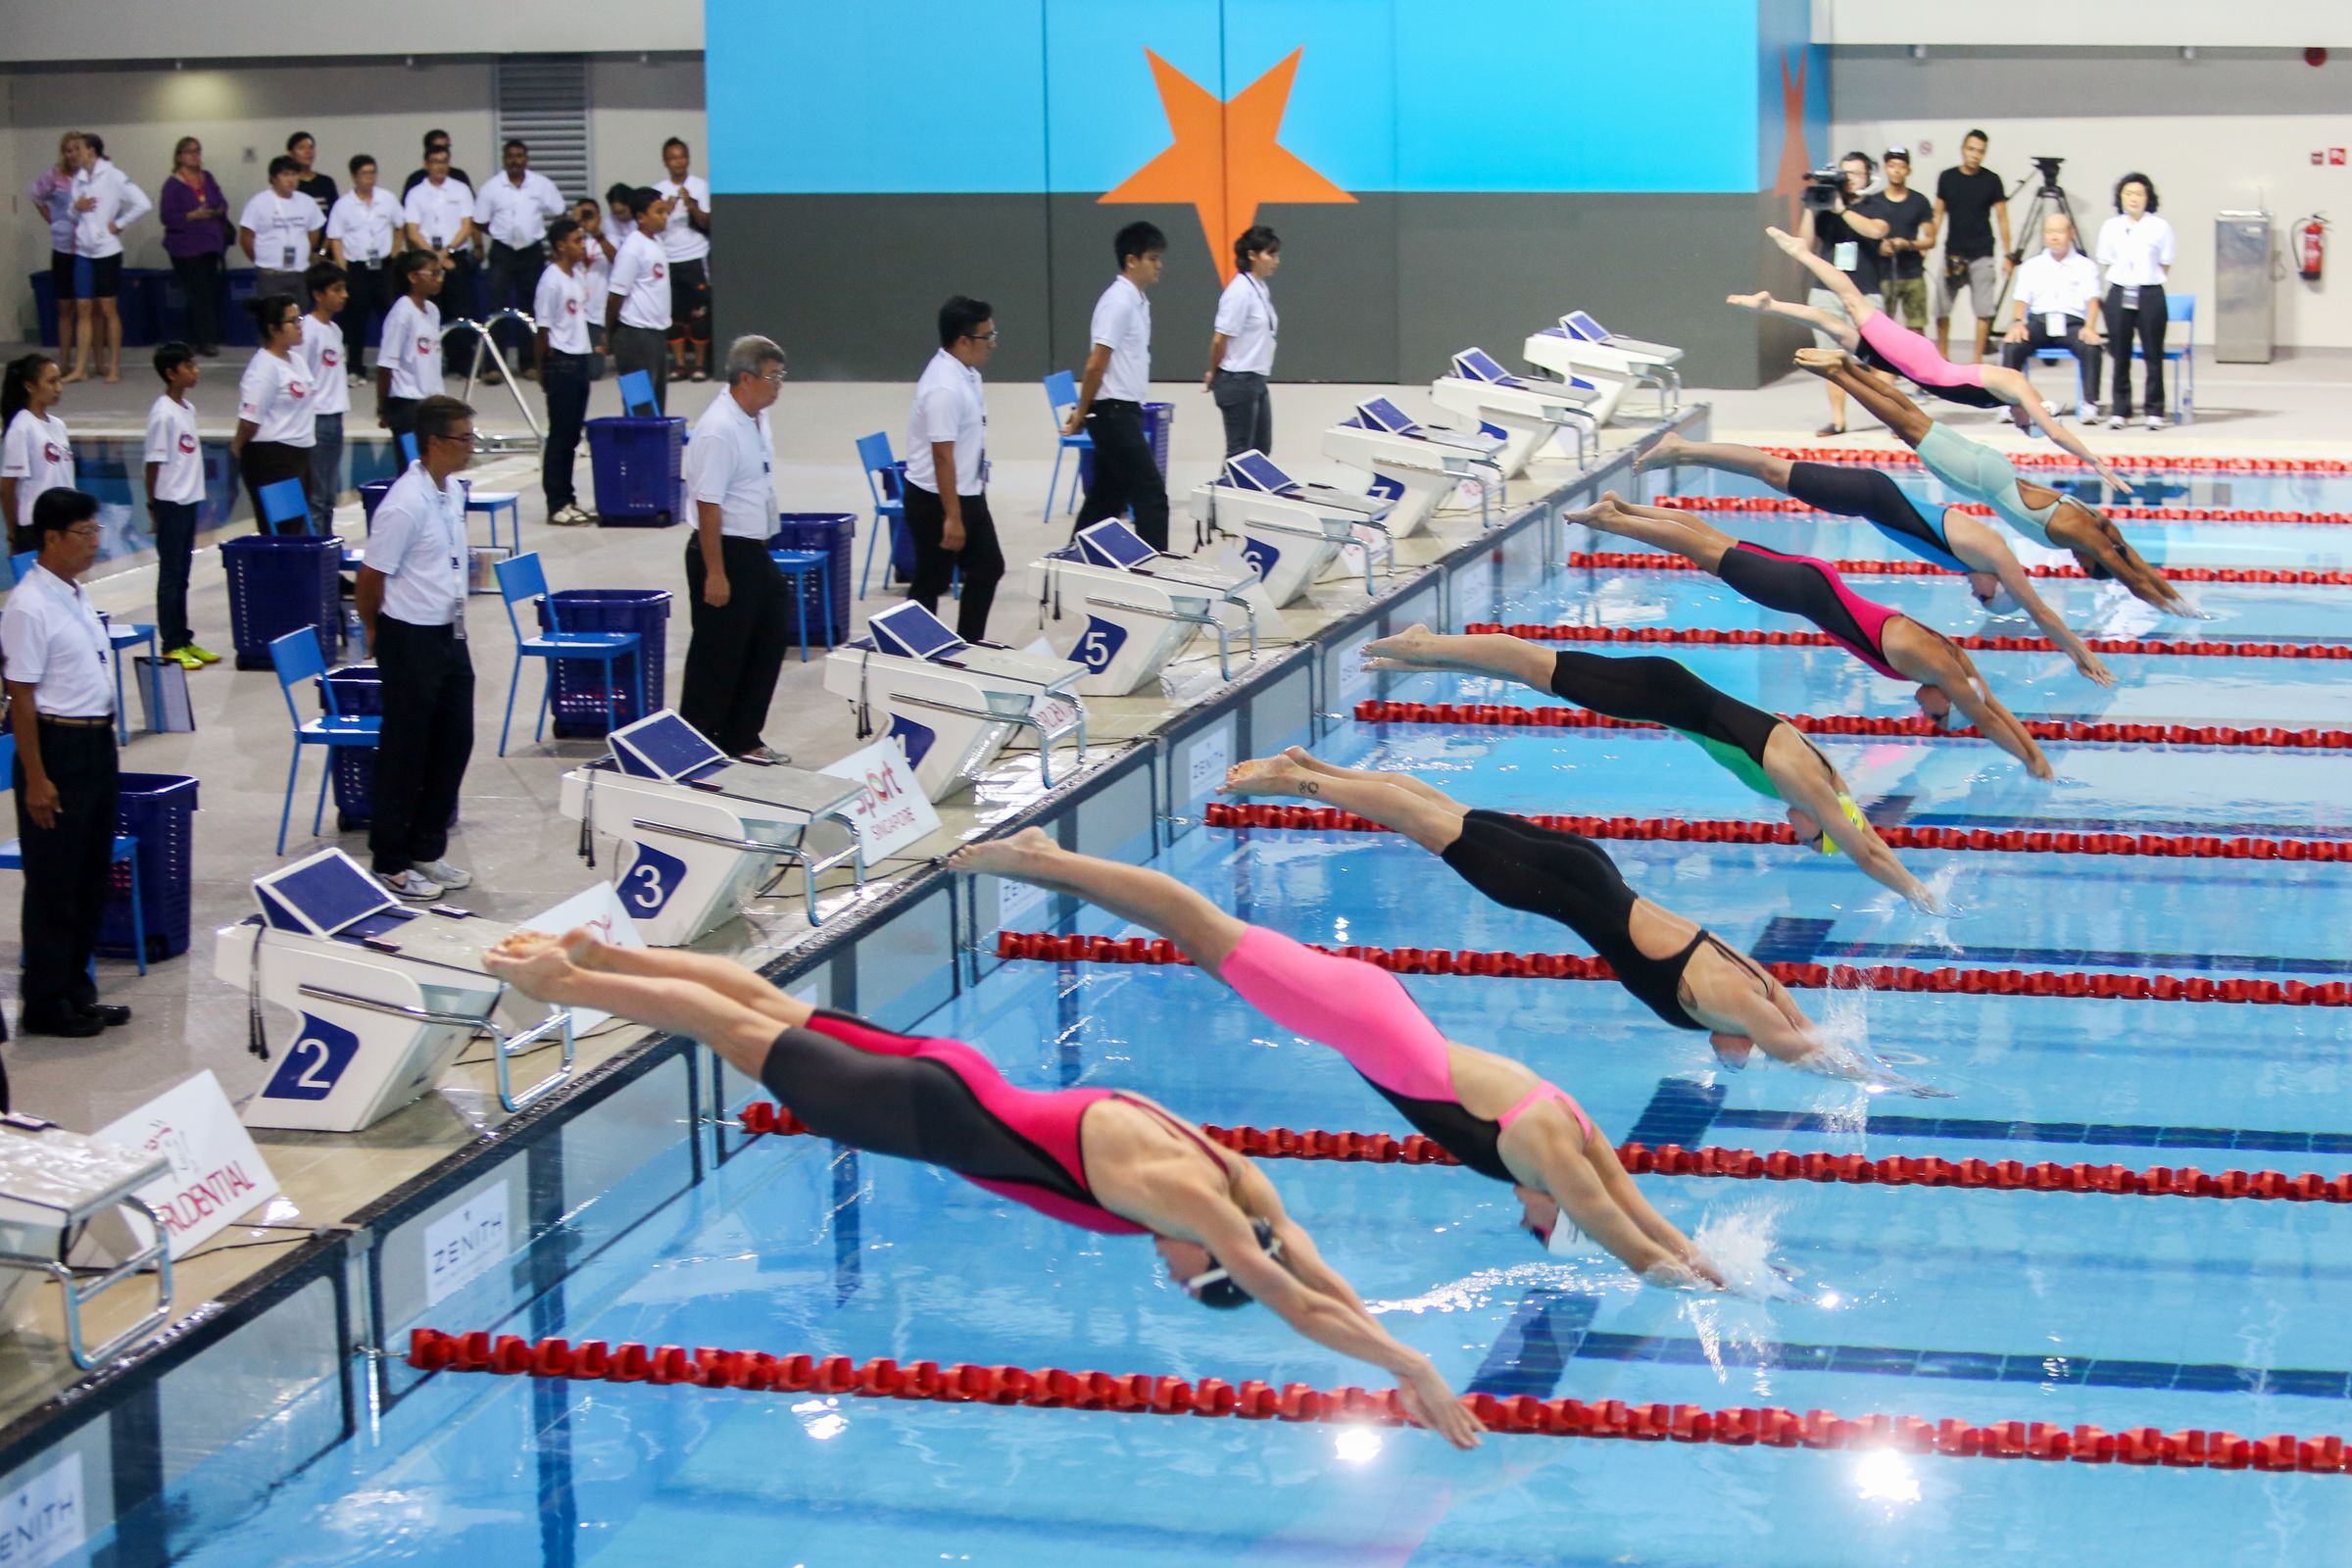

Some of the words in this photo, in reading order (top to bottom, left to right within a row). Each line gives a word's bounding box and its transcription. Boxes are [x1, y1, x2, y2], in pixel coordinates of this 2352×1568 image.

[1243, 550, 1263, 580] 6
[1085, 632, 1108, 665] 5
[634, 864, 663, 908] 3
[297, 1039, 331, 1088] 2
[158, 1160, 257, 1237] RUDENTIAL
[434, 1211, 503, 1274] ZENITH
[0, 1493, 74, 1560] ENITH
